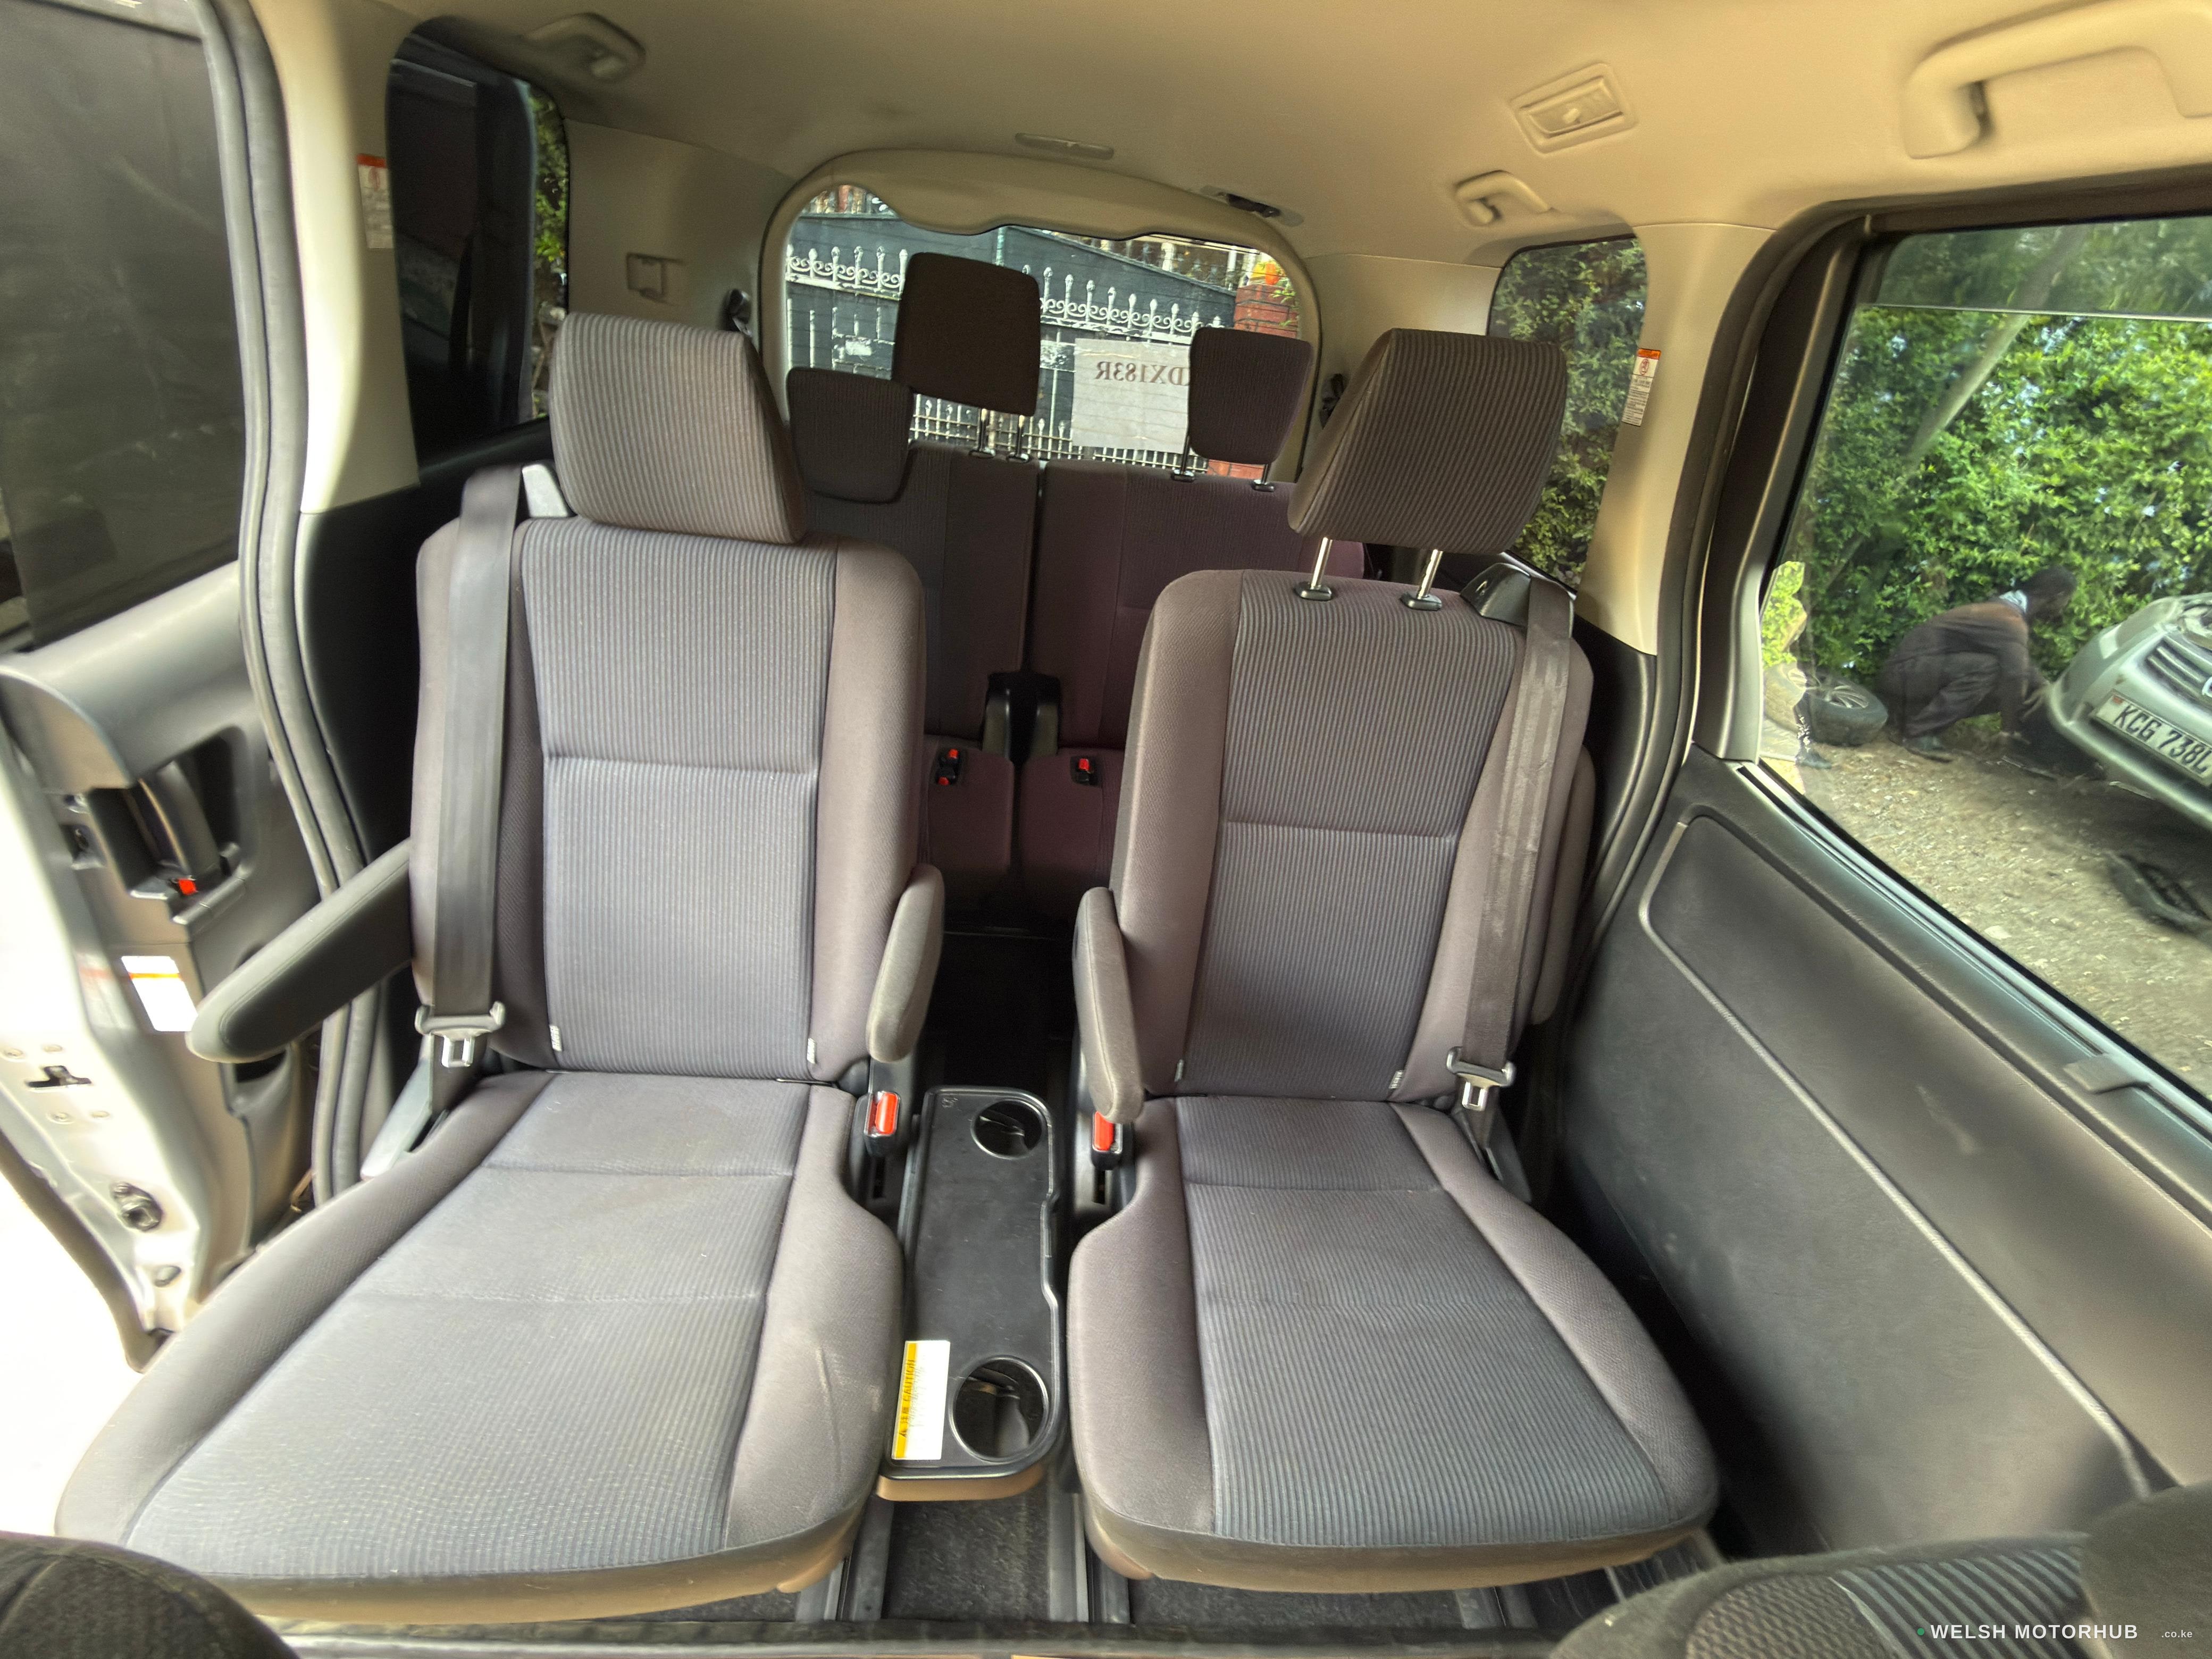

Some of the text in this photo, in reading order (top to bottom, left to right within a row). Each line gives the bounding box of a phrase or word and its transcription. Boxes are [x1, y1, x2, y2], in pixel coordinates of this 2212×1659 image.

[2113, 705, 2212, 773] KCG 738L
[903, 1359, 916, 1402] CAUTION
